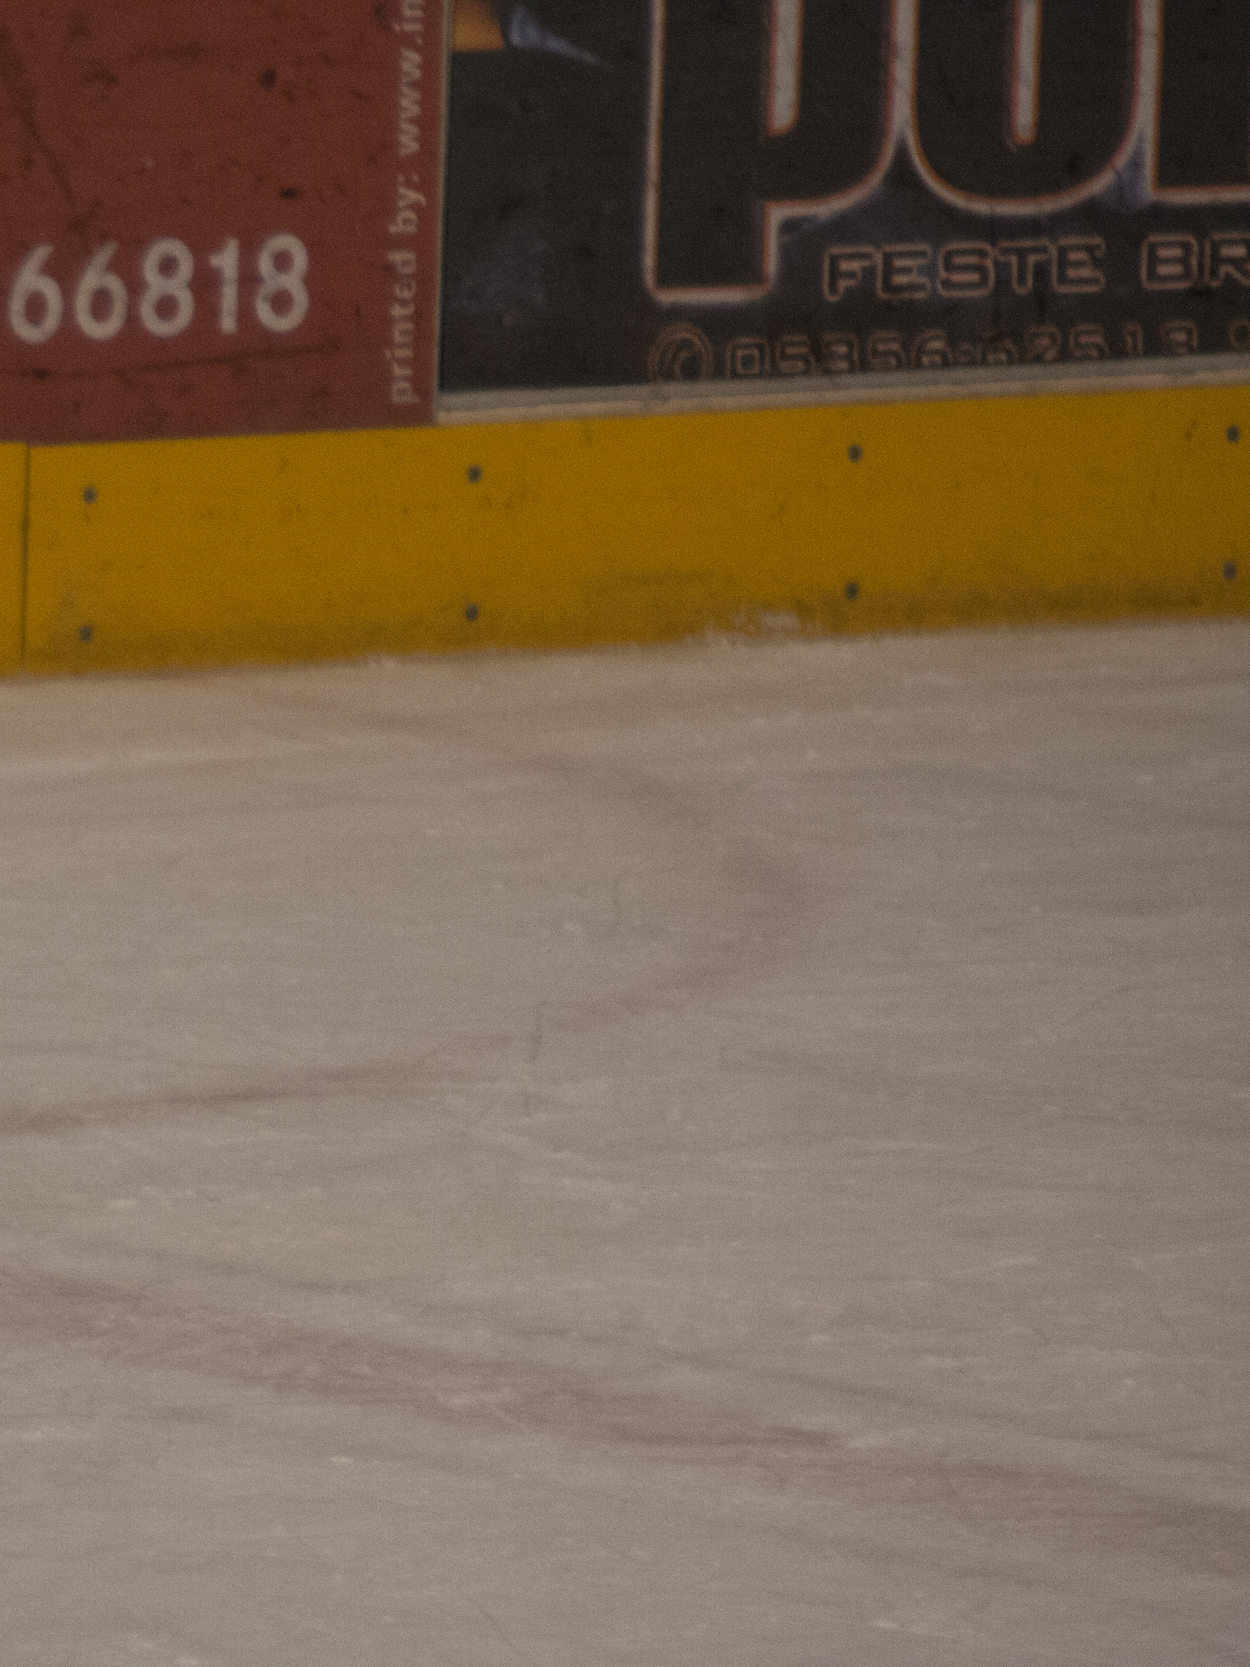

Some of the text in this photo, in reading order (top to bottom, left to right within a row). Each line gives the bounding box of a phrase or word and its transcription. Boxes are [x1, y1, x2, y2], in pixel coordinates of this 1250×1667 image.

[387, 171, 428, 234] by:
[7, 231, 311, 345] 66818
[822, 235, 1107, 302] FESTE
[383, 249, 421, 405] printed
